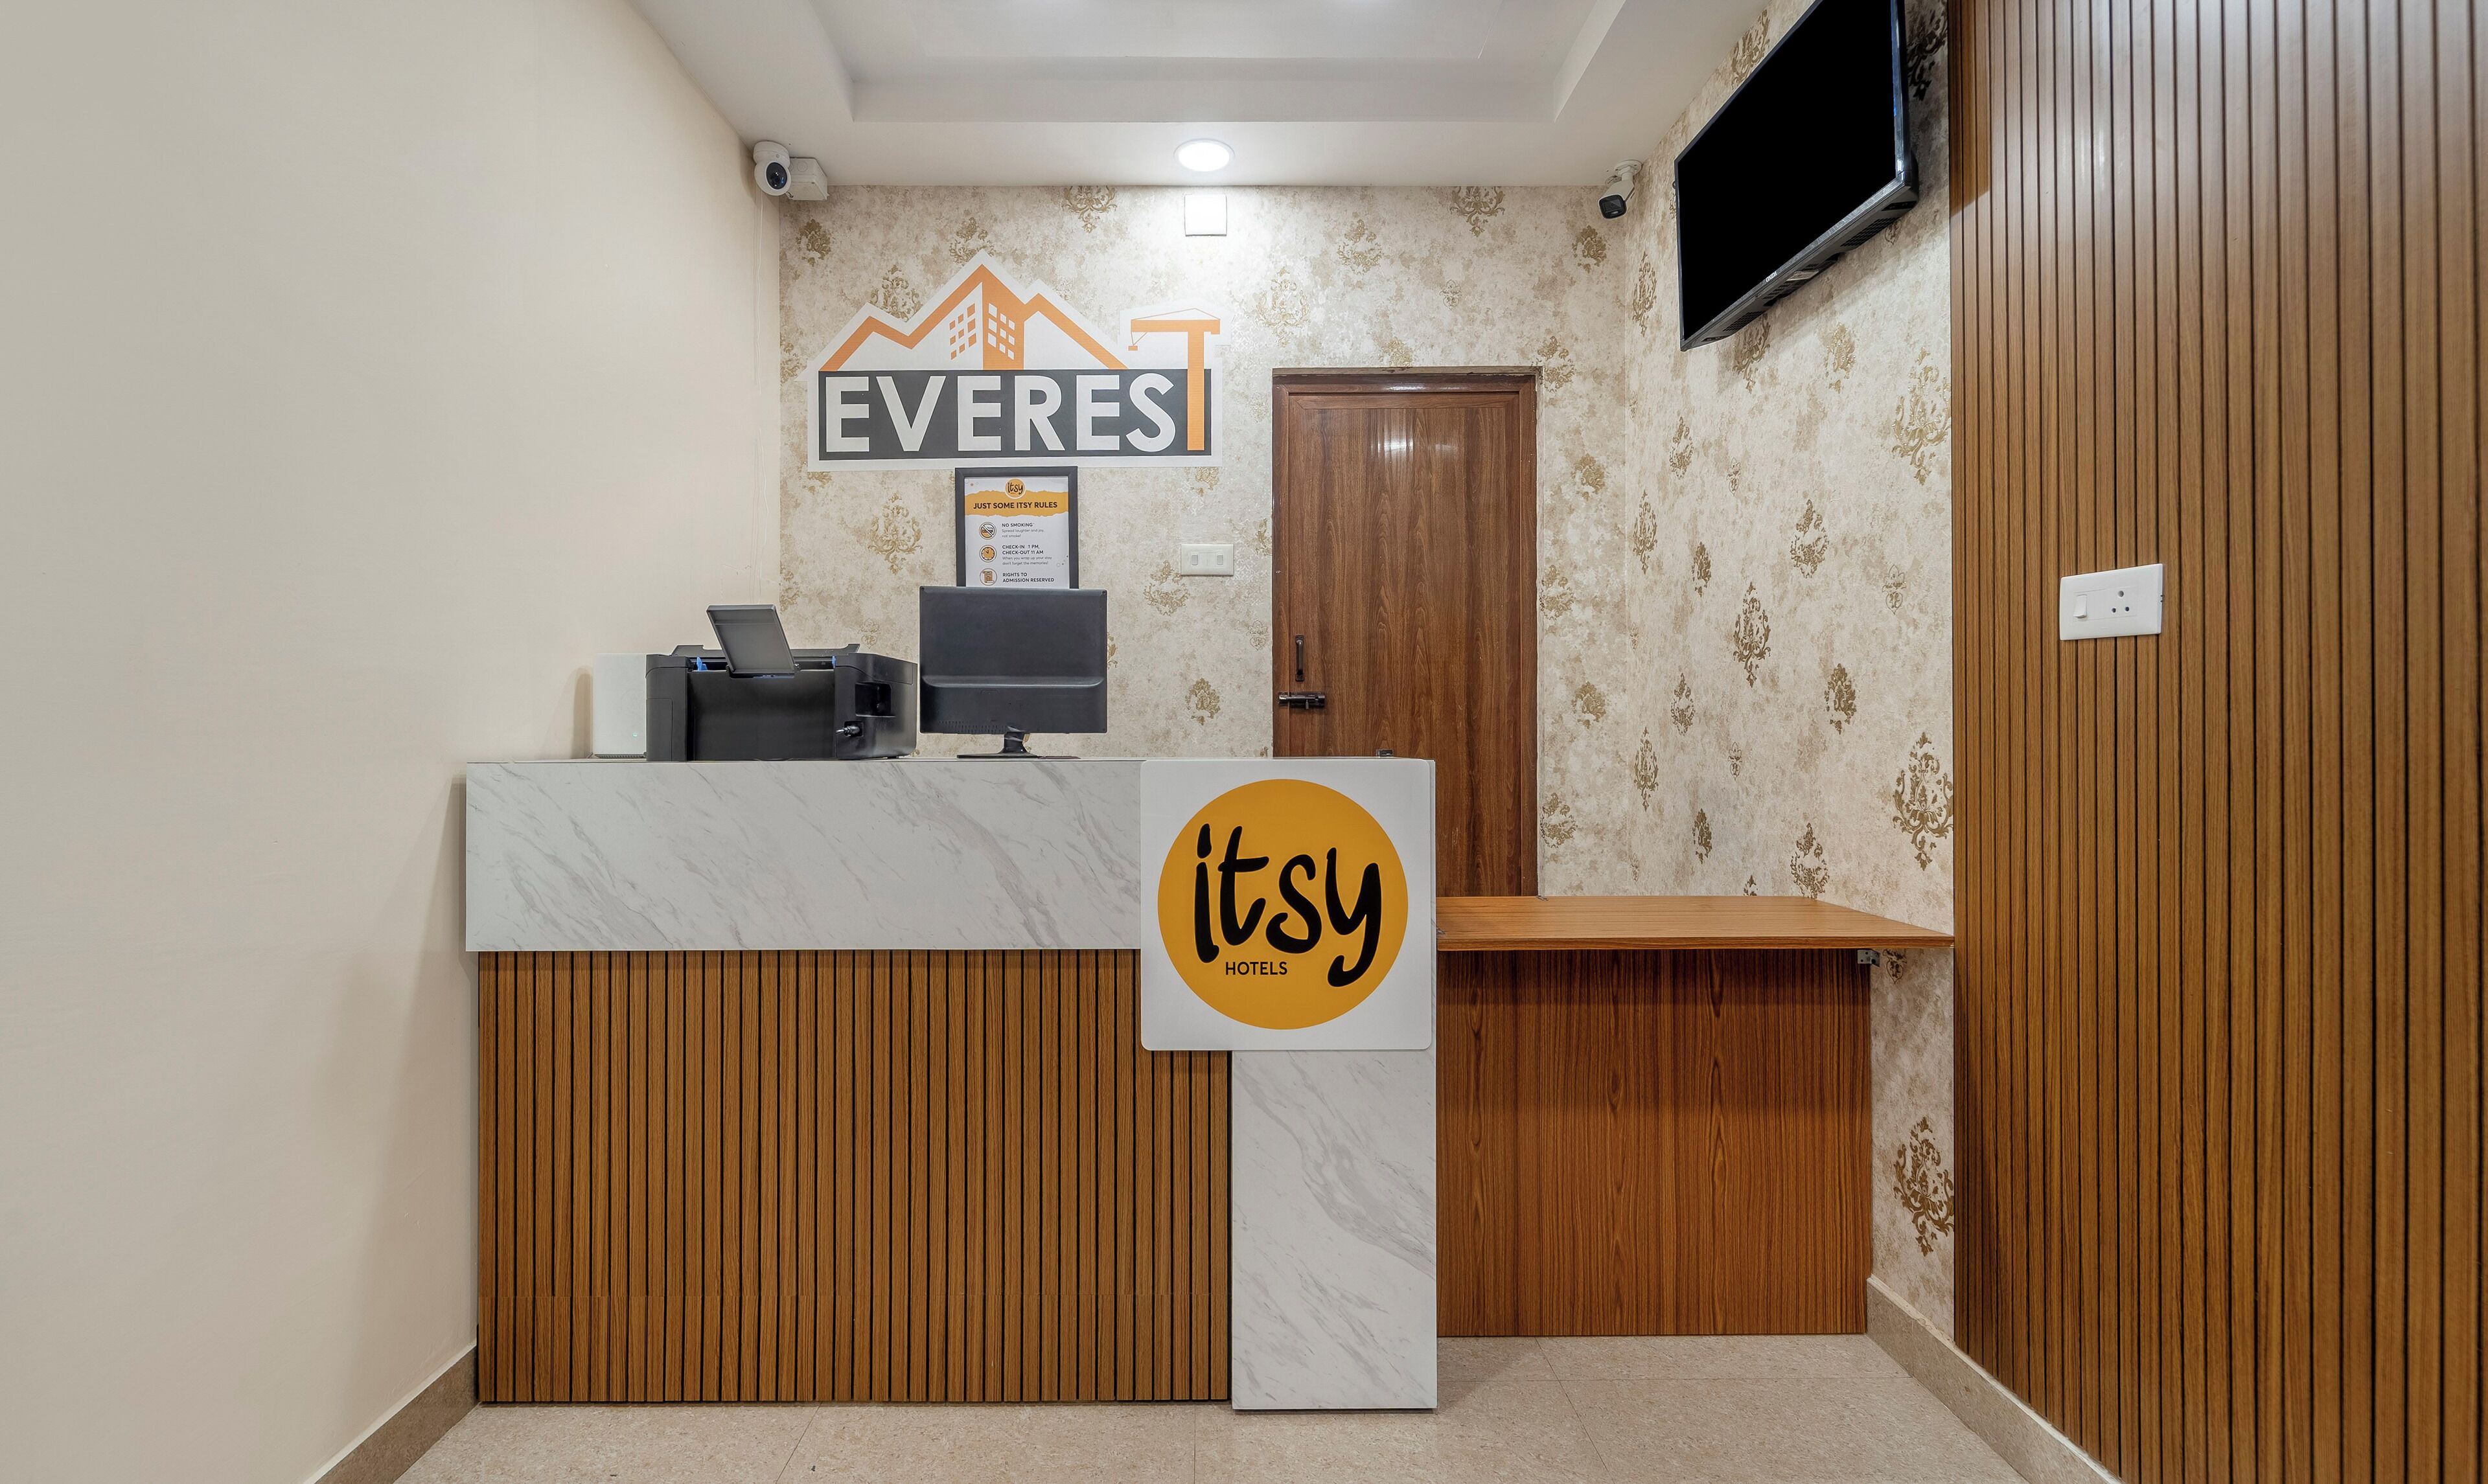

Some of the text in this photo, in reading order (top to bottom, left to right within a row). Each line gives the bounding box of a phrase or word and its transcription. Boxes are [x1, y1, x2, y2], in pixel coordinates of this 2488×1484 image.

[825, 317, 1220, 452] EVEREST
[1008, 482, 1023, 495] itsy
[1194, 823, 1382, 987] itsy
[1225, 961, 1287, 976] HOTELS
